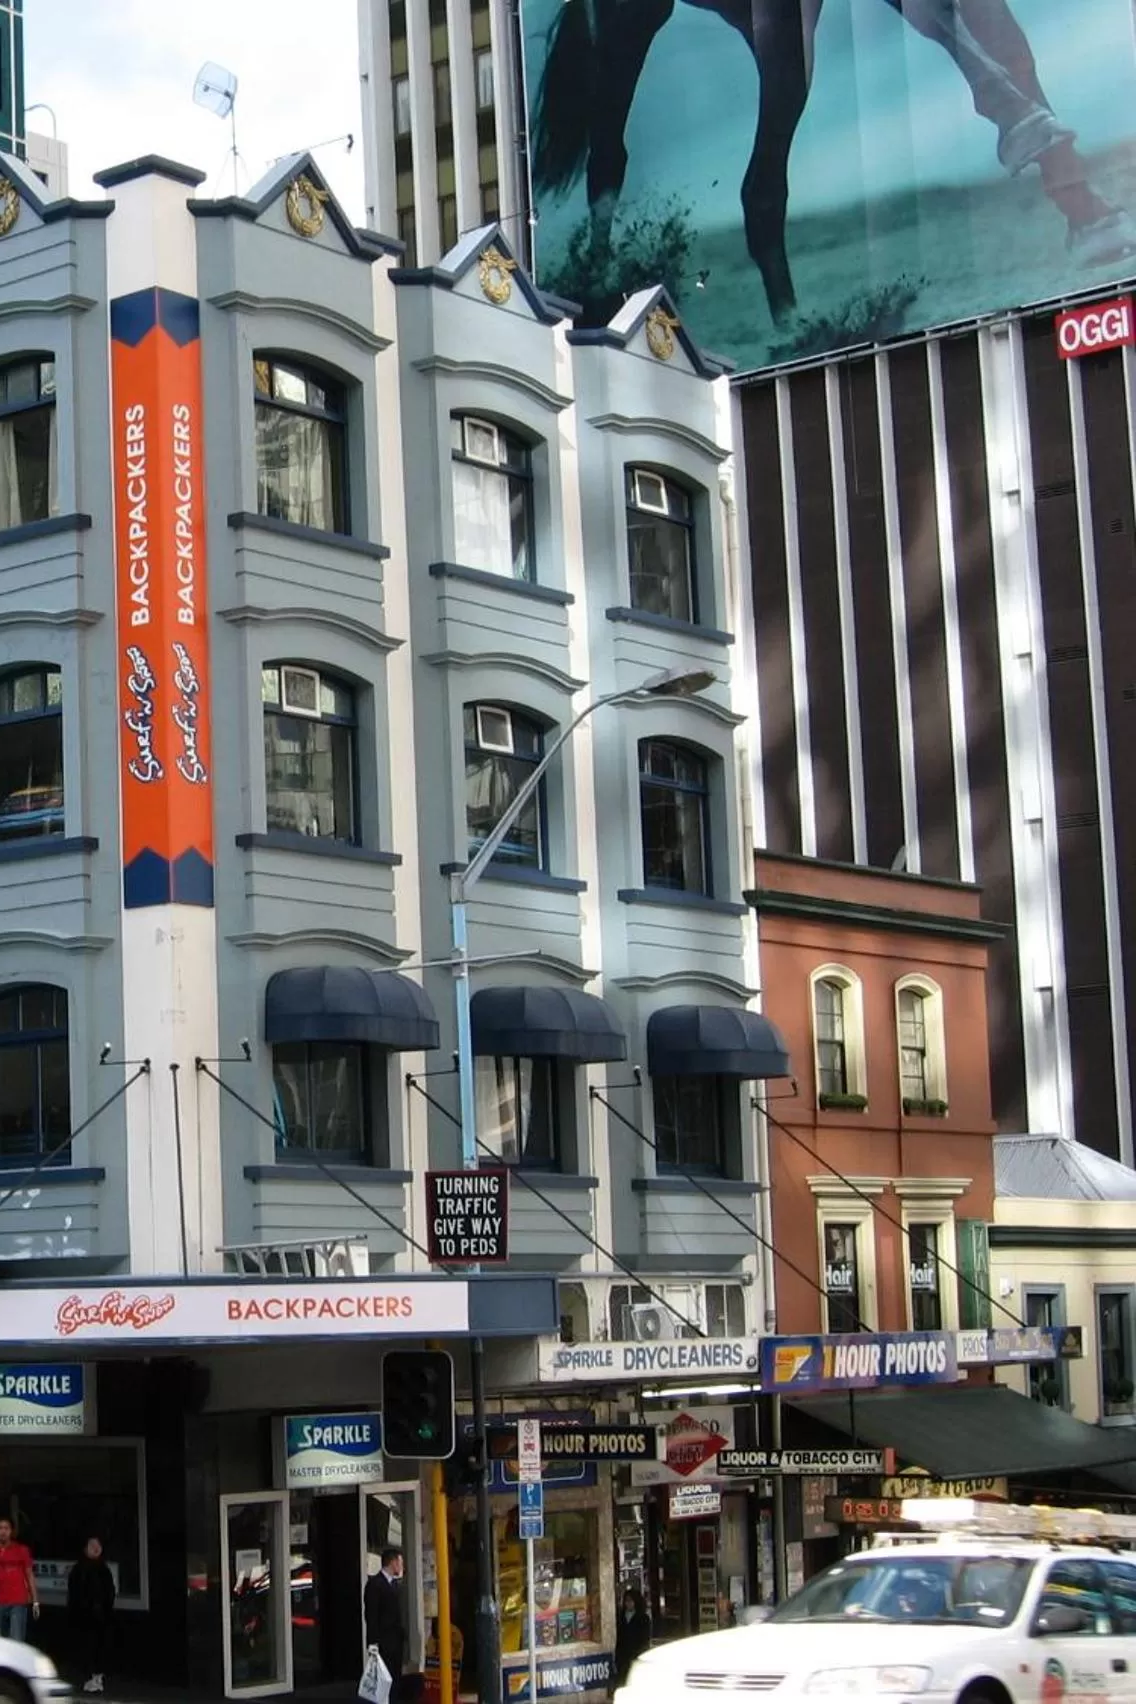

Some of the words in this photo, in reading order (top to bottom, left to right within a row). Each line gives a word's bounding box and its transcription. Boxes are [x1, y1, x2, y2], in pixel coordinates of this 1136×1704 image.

[1060, 306, 1129, 351] OGGI
[125, 404, 150, 626] BACKPACKERS
[172, 404, 195, 625] BACKPACKERS
[435, 1176, 499, 1194] TURNING
[437, 1197, 496, 1215] TRAFFIC
[434, 1218, 465, 1235] GIVE
[471, 1217, 501, 1235] WAY
[439, 1239, 455, 1255] TO
[460, 1238, 497, 1255] PEDS
[228, 1297, 413, 1321] BACKPACKERS
[553, 1350, 613, 1370] SPARKLE
[623, 1344, 743, 1371] DRYCLEANERS
[823, 1345, 833, 1378] 1
[834, 1344, 881, 1378] HOUR
[885, 1340, 946, 1376] PHOTOS
[18, 1414, 82, 1426] DRYCLEANERS
[297, 1424, 371, 1447] SPARKLE
[543, 1435, 584, 1453] HOUR
[589, 1434, 645, 1453] PHOTOS
[720, 1452, 767, 1465] LIQUOR
[770, 1452, 779, 1465] &
[785, 1452, 849, 1465] TOBACCO
[852, 1452, 882, 1465] CITY
[289, 1466, 322, 1477] MASTER
[542, 1668, 570, 1688] HOUR
[572, 1662, 610, 1685] PHOTOS
